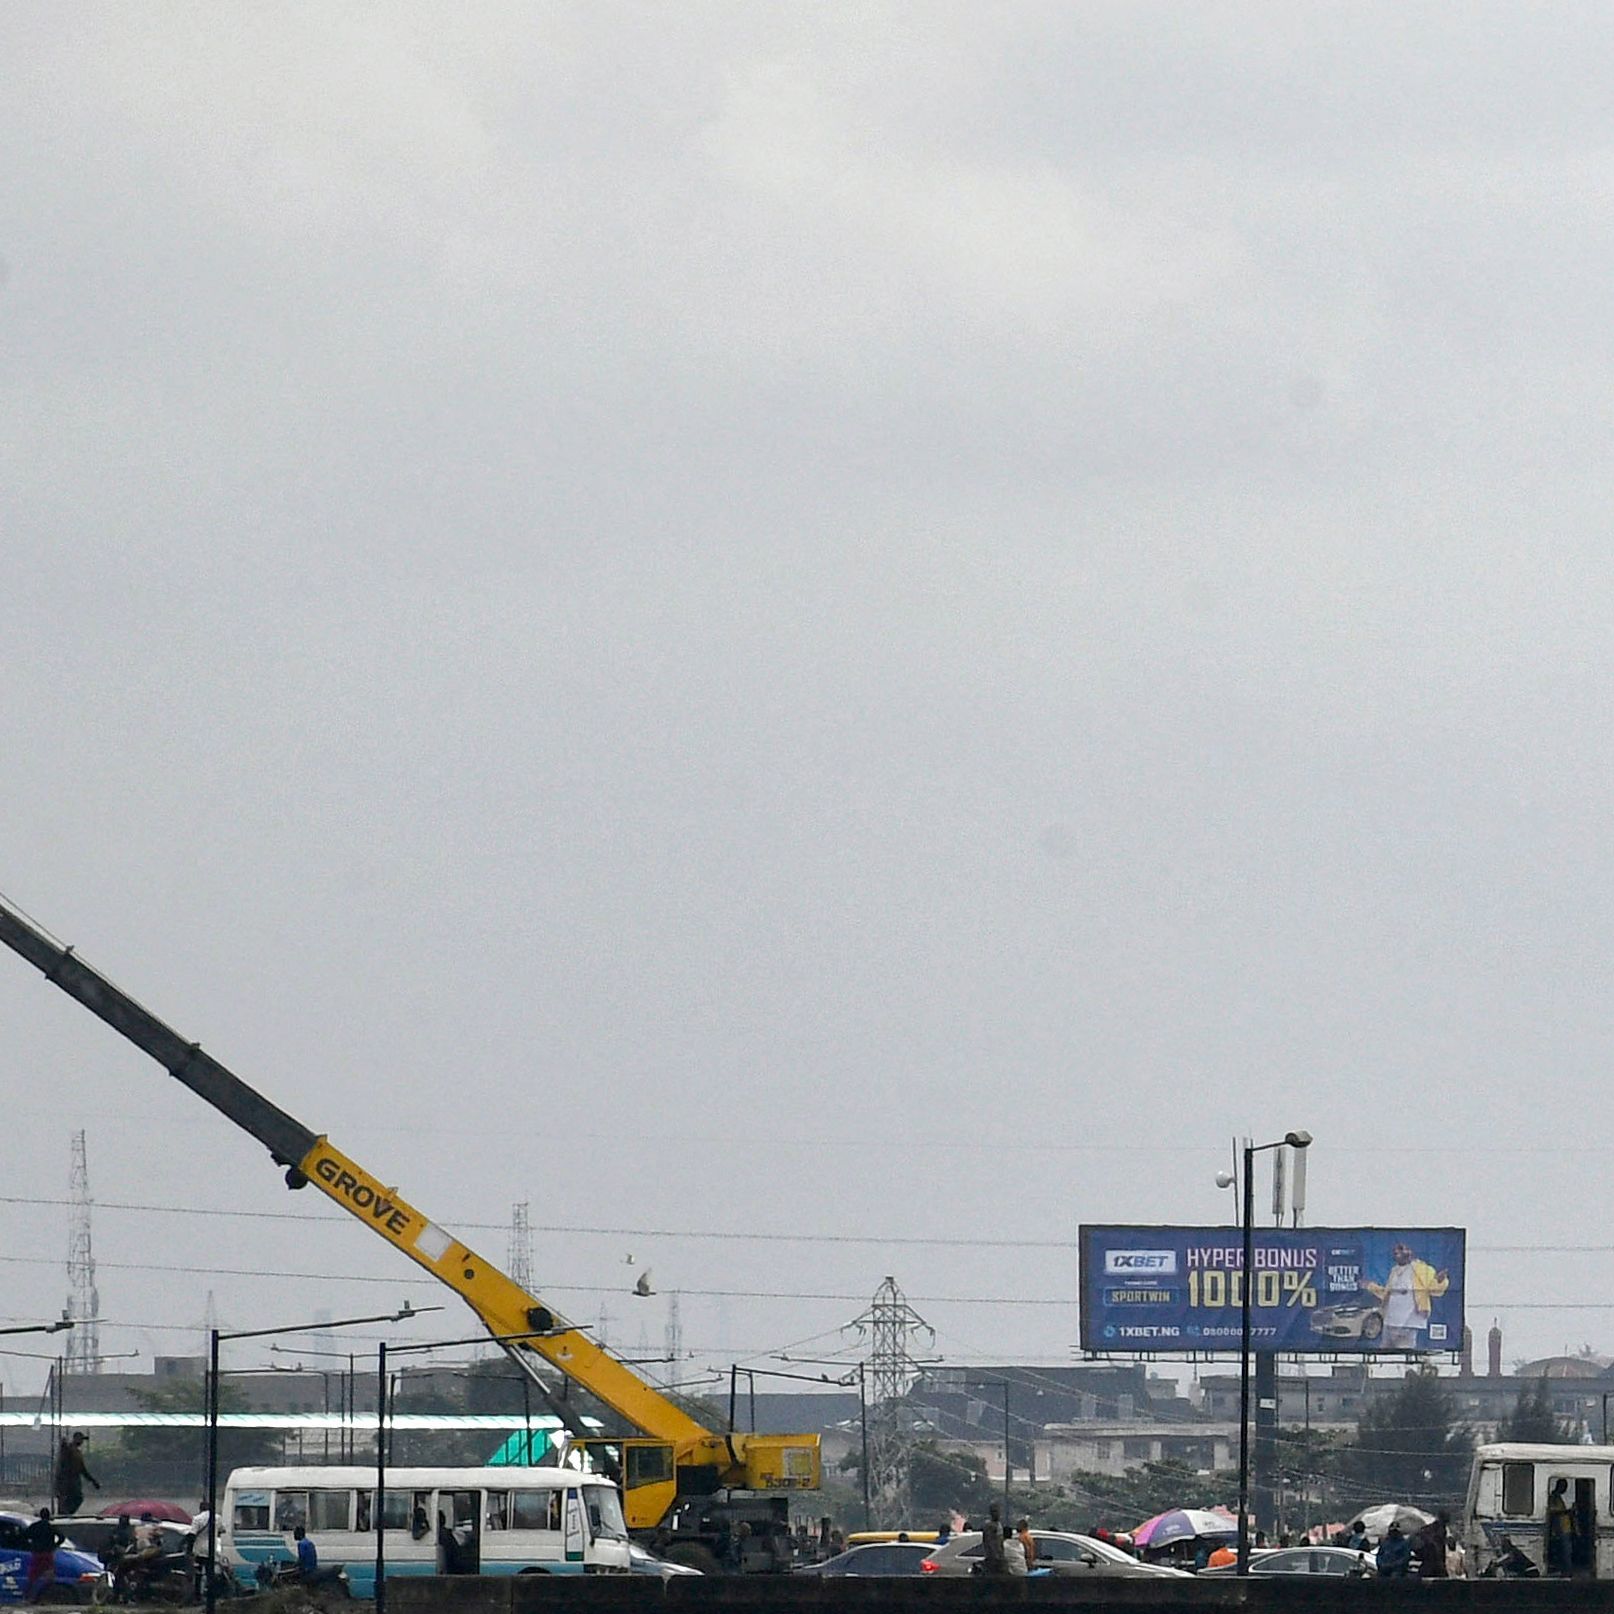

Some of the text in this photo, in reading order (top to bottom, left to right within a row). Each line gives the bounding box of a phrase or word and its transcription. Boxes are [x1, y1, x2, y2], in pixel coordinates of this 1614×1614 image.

[315, 1158, 411, 1236] GROVE
[1113, 1255, 1168, 1268] 1XBET
[1187, 1249, 1317, 1267] HYPER BONUS
[1189, 1270, 1317, 1307] 1000%
[1112, 1291, 1170, 1303] SPORTWIN
[1119, 1327, 1180, 1336] 1XBET.NG
